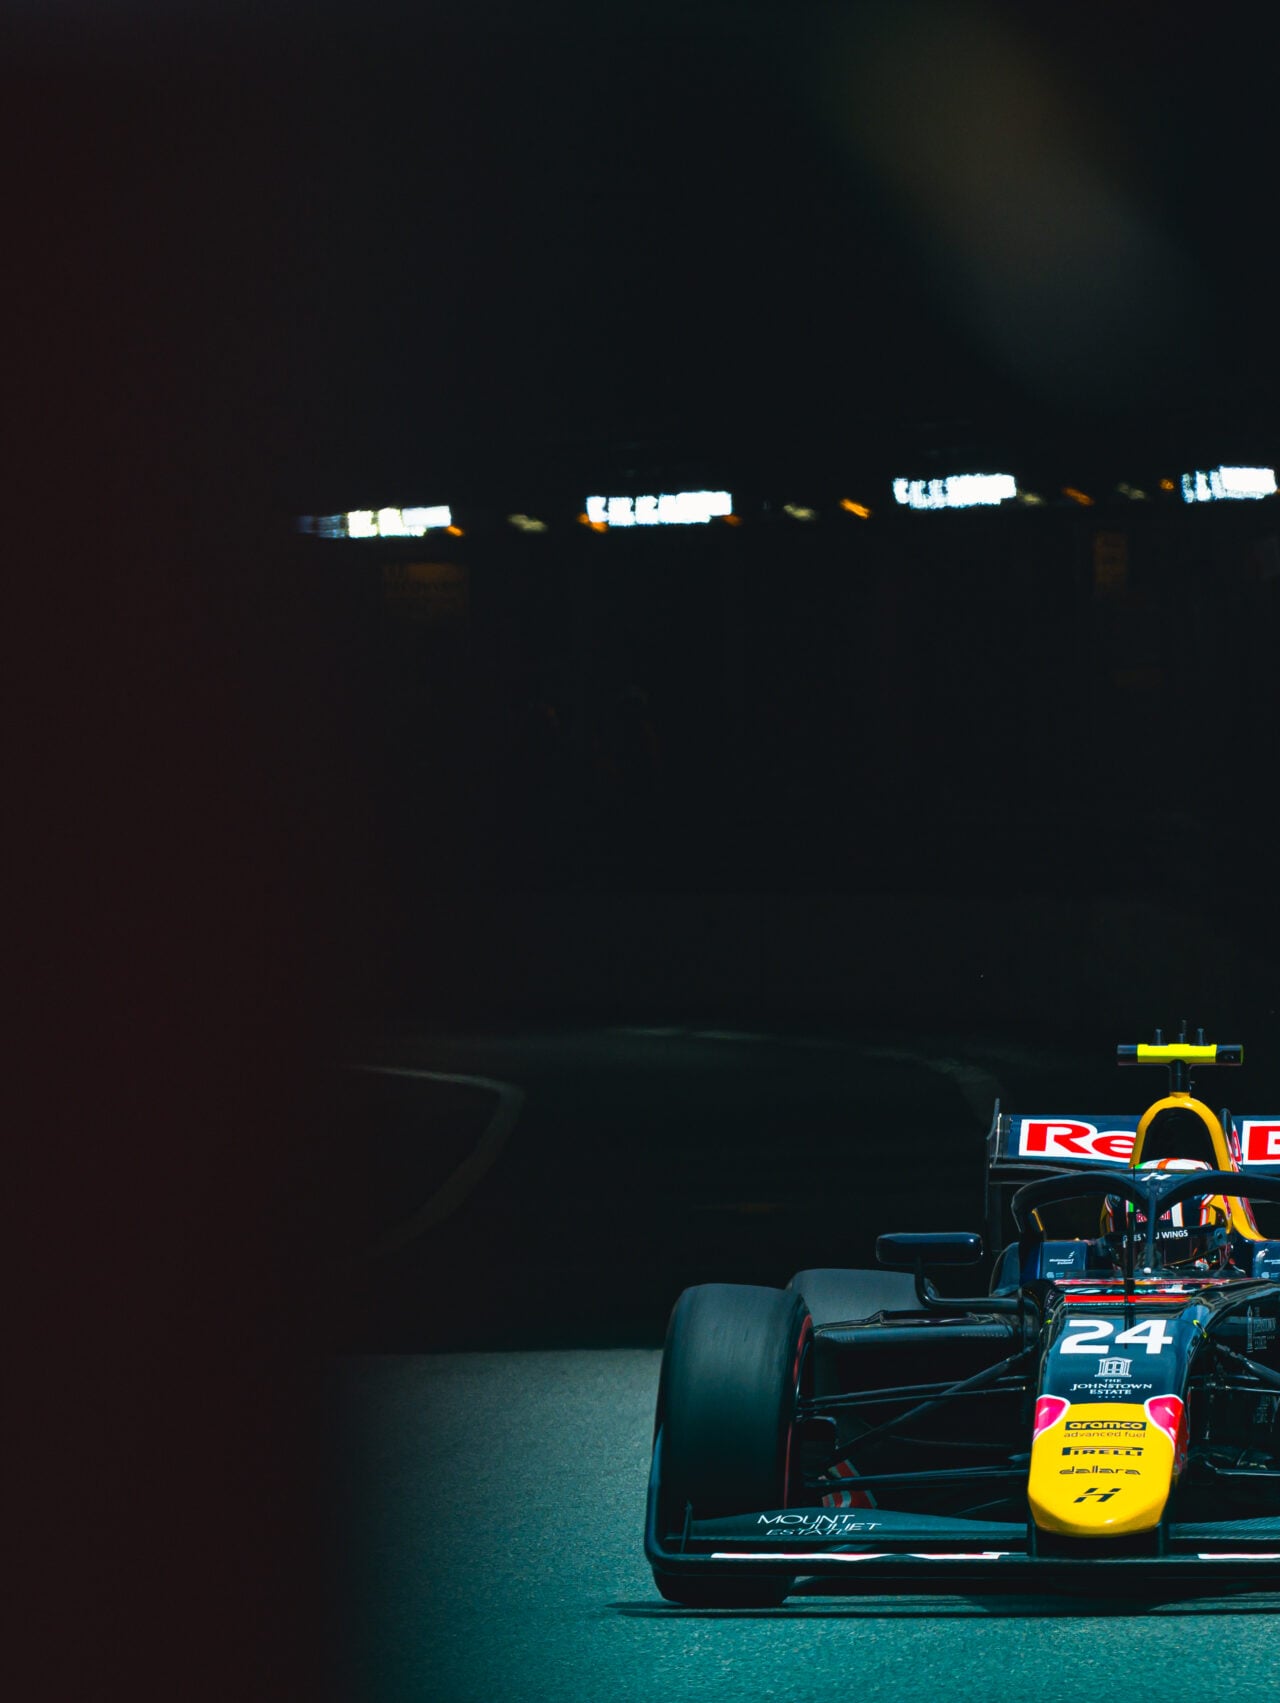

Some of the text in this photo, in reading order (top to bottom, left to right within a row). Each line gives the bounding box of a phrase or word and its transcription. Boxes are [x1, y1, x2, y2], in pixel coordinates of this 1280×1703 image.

[1026, 1123, 1136, 1159] Re
[1161, 1229, 1189, 1239] WINGS
[1060, 1319, 1173, 1354] 24
[1070, 1383, 1153, 1391] JOHNSTOWN
[1062, 1446, 1144, 1456] PIRELLI
[1059, 1465, 1141, 1475] dallara
[757, 1514, 855, 1524] MOUNT
